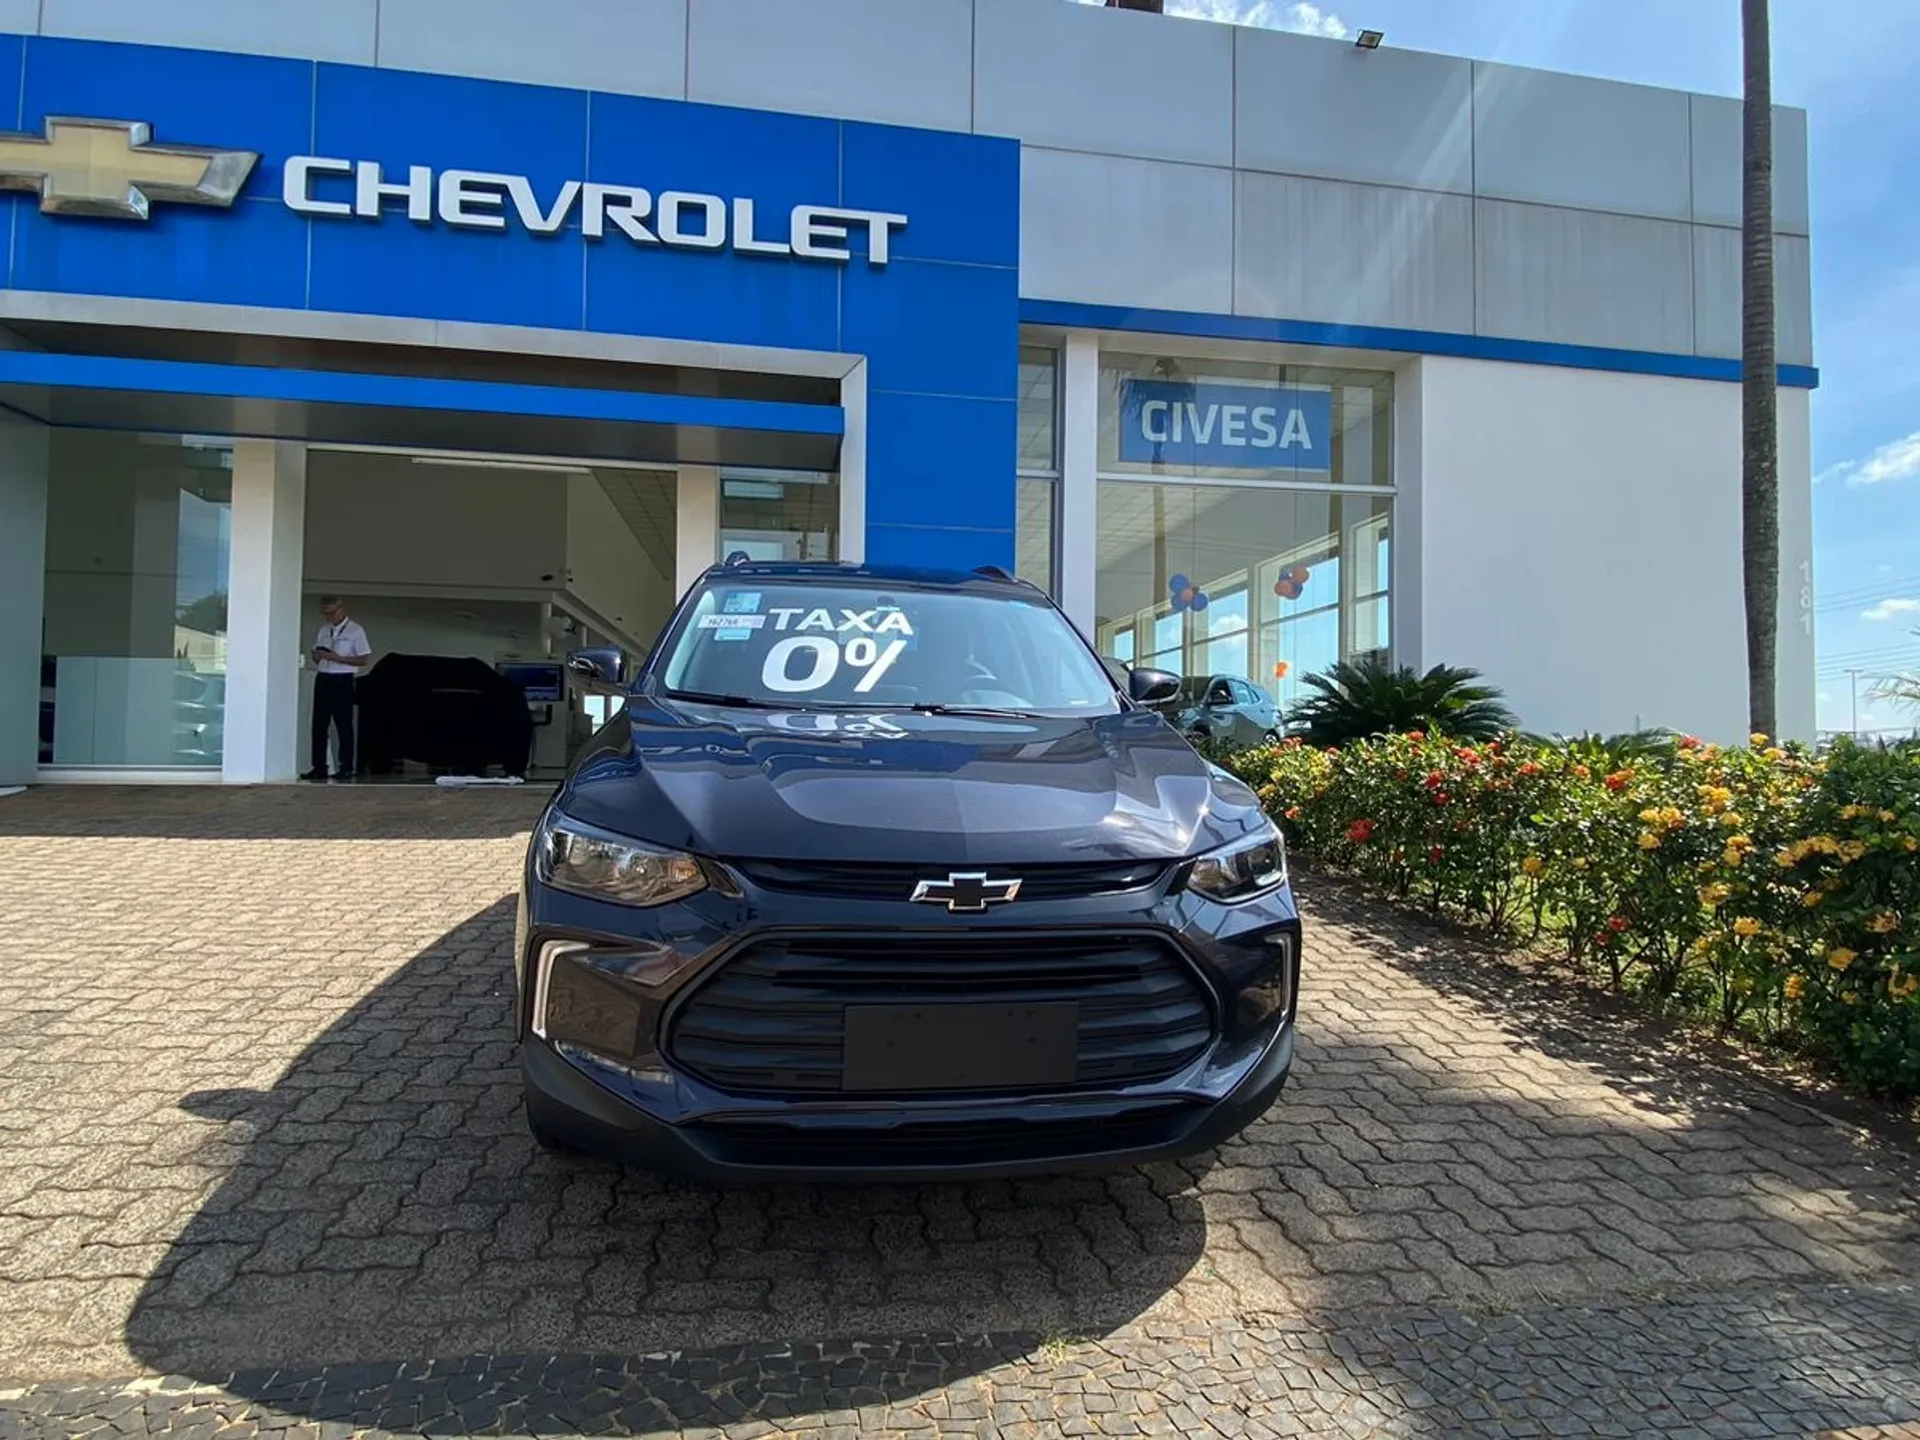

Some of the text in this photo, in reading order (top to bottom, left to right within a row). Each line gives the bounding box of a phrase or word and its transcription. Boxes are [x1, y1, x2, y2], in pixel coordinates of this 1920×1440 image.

[283, 155, 908, 265] CHEVROLET
[1141, 399, 1313, 450] CIVESA
[768, 608, 914, 635] TAXA
[761, 636, 909, 693] 0%
